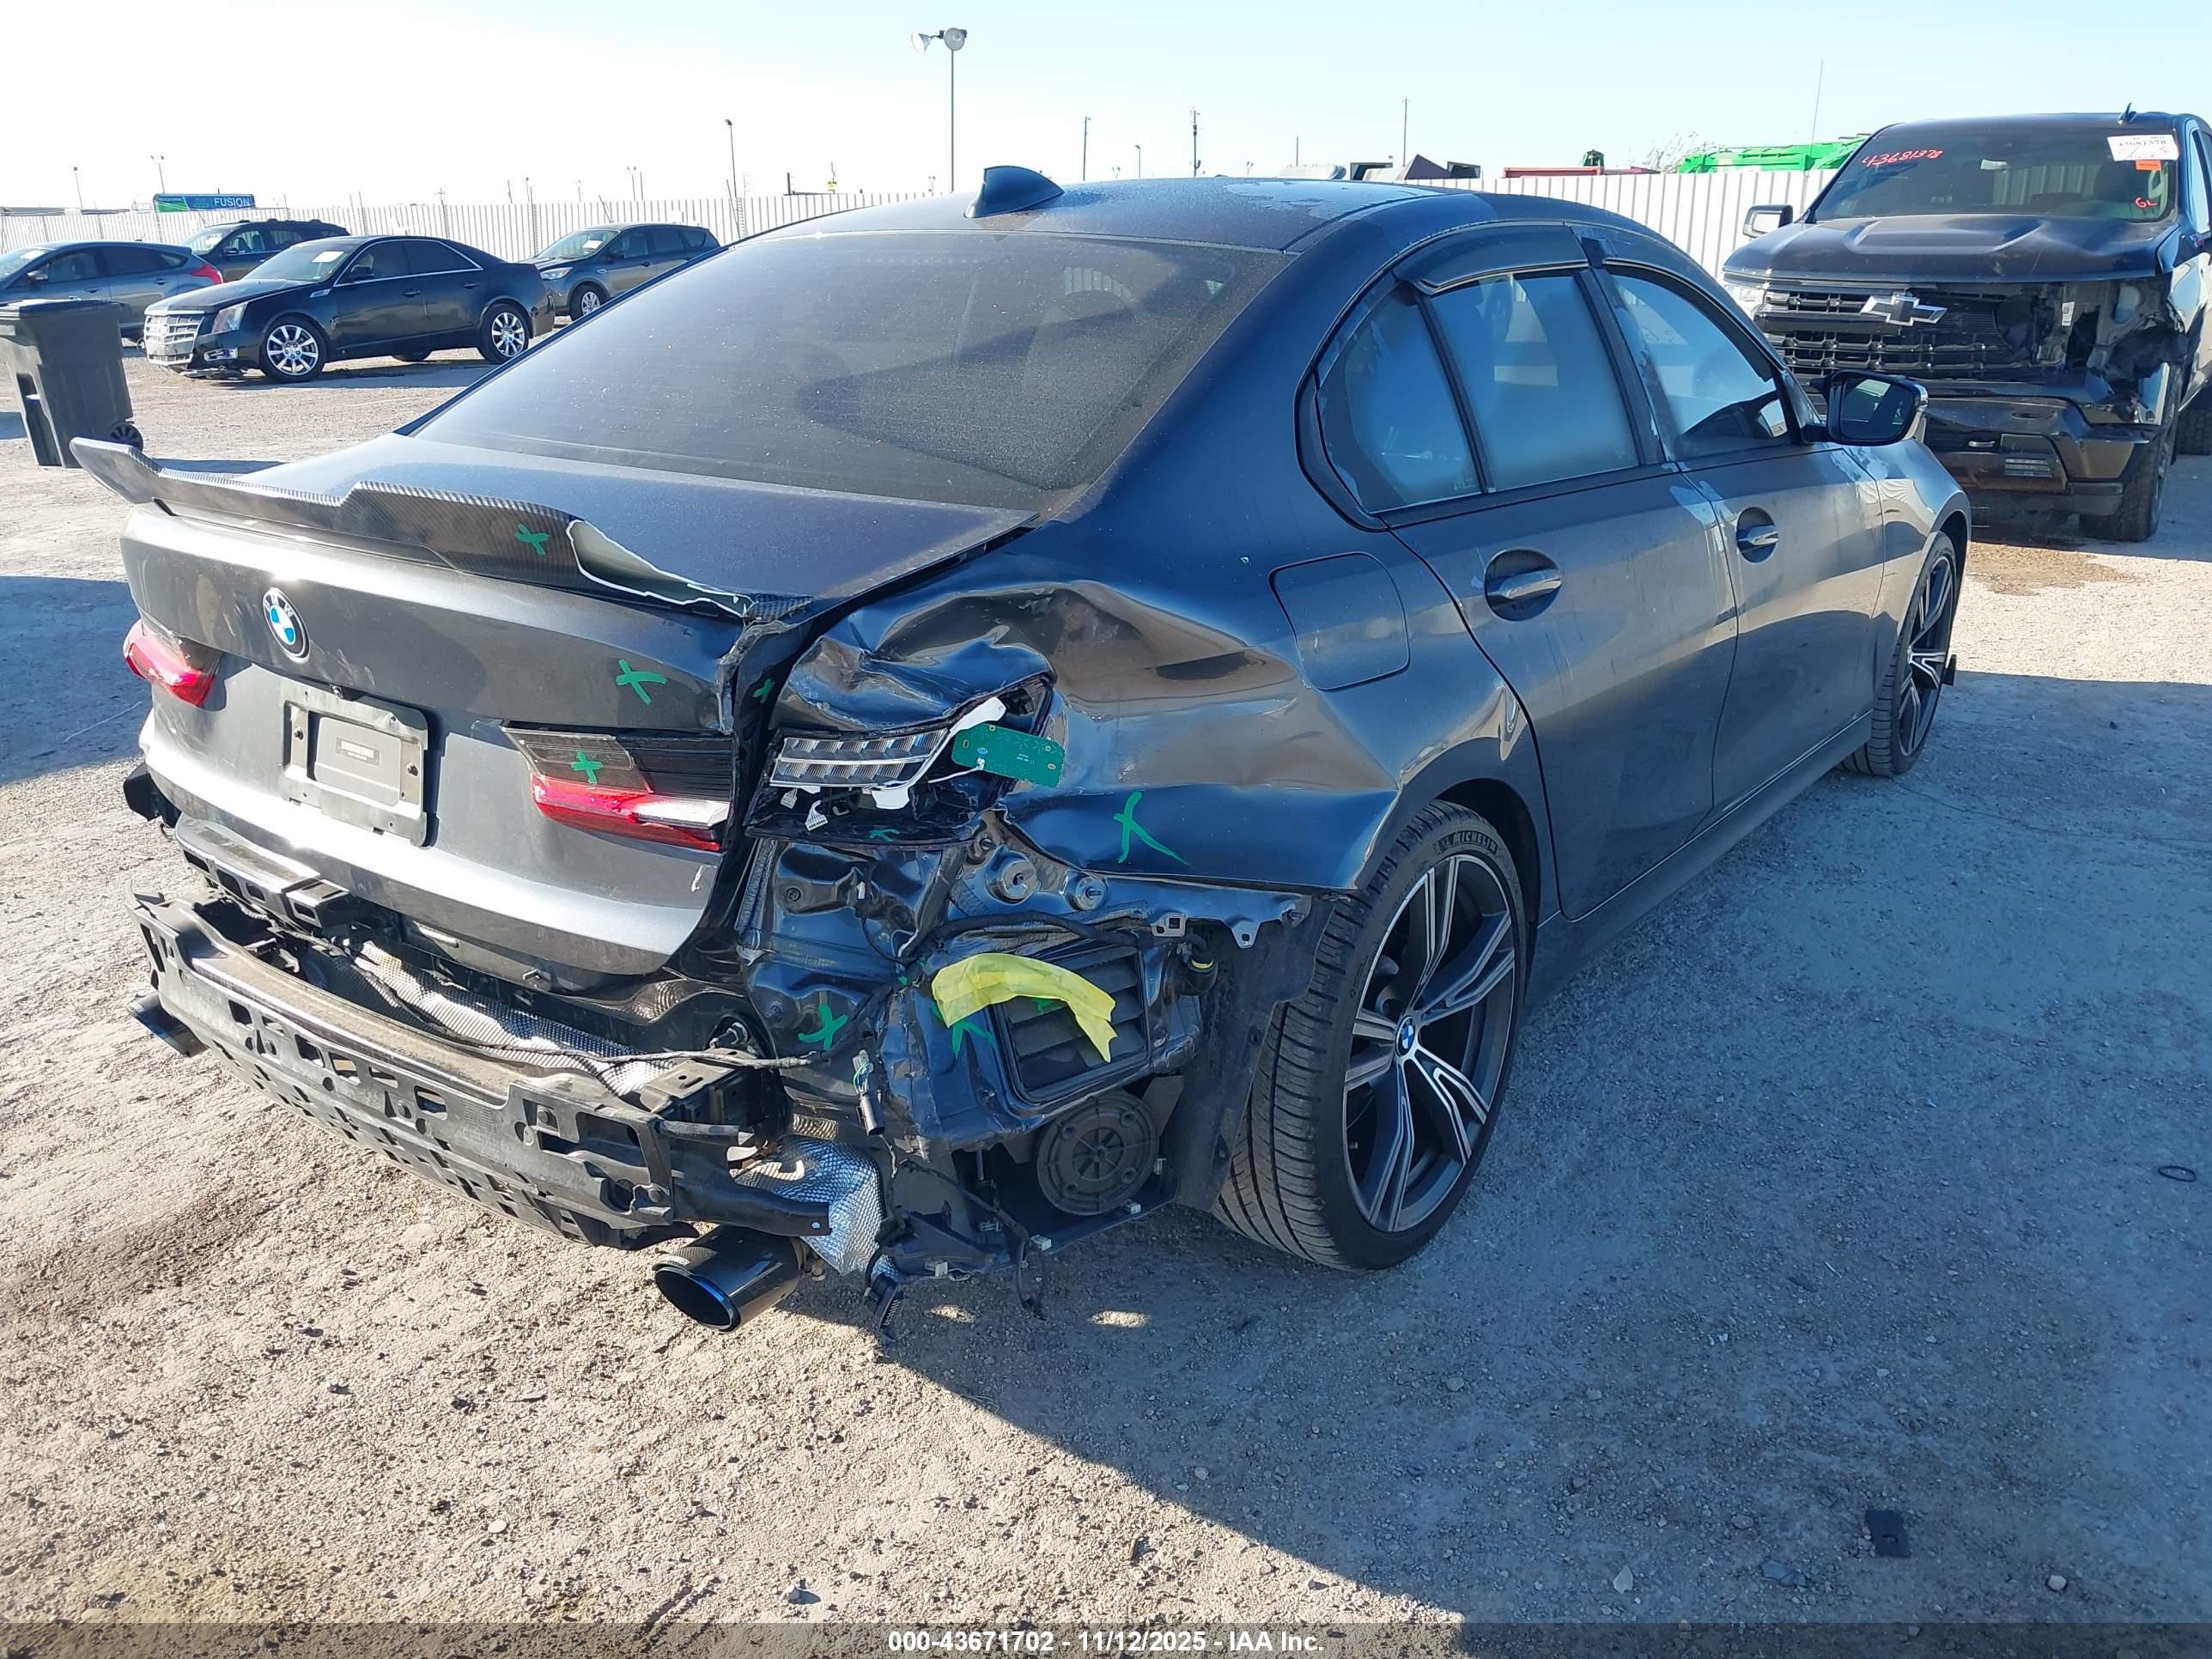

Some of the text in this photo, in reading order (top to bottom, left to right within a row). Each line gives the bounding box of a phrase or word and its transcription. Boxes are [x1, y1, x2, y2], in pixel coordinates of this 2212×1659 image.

[1862, 149, 1943, 167] 43681378
[214, 198, 251, 207] FUSION
[1452, 830, 1498, 855] MICHELIN
